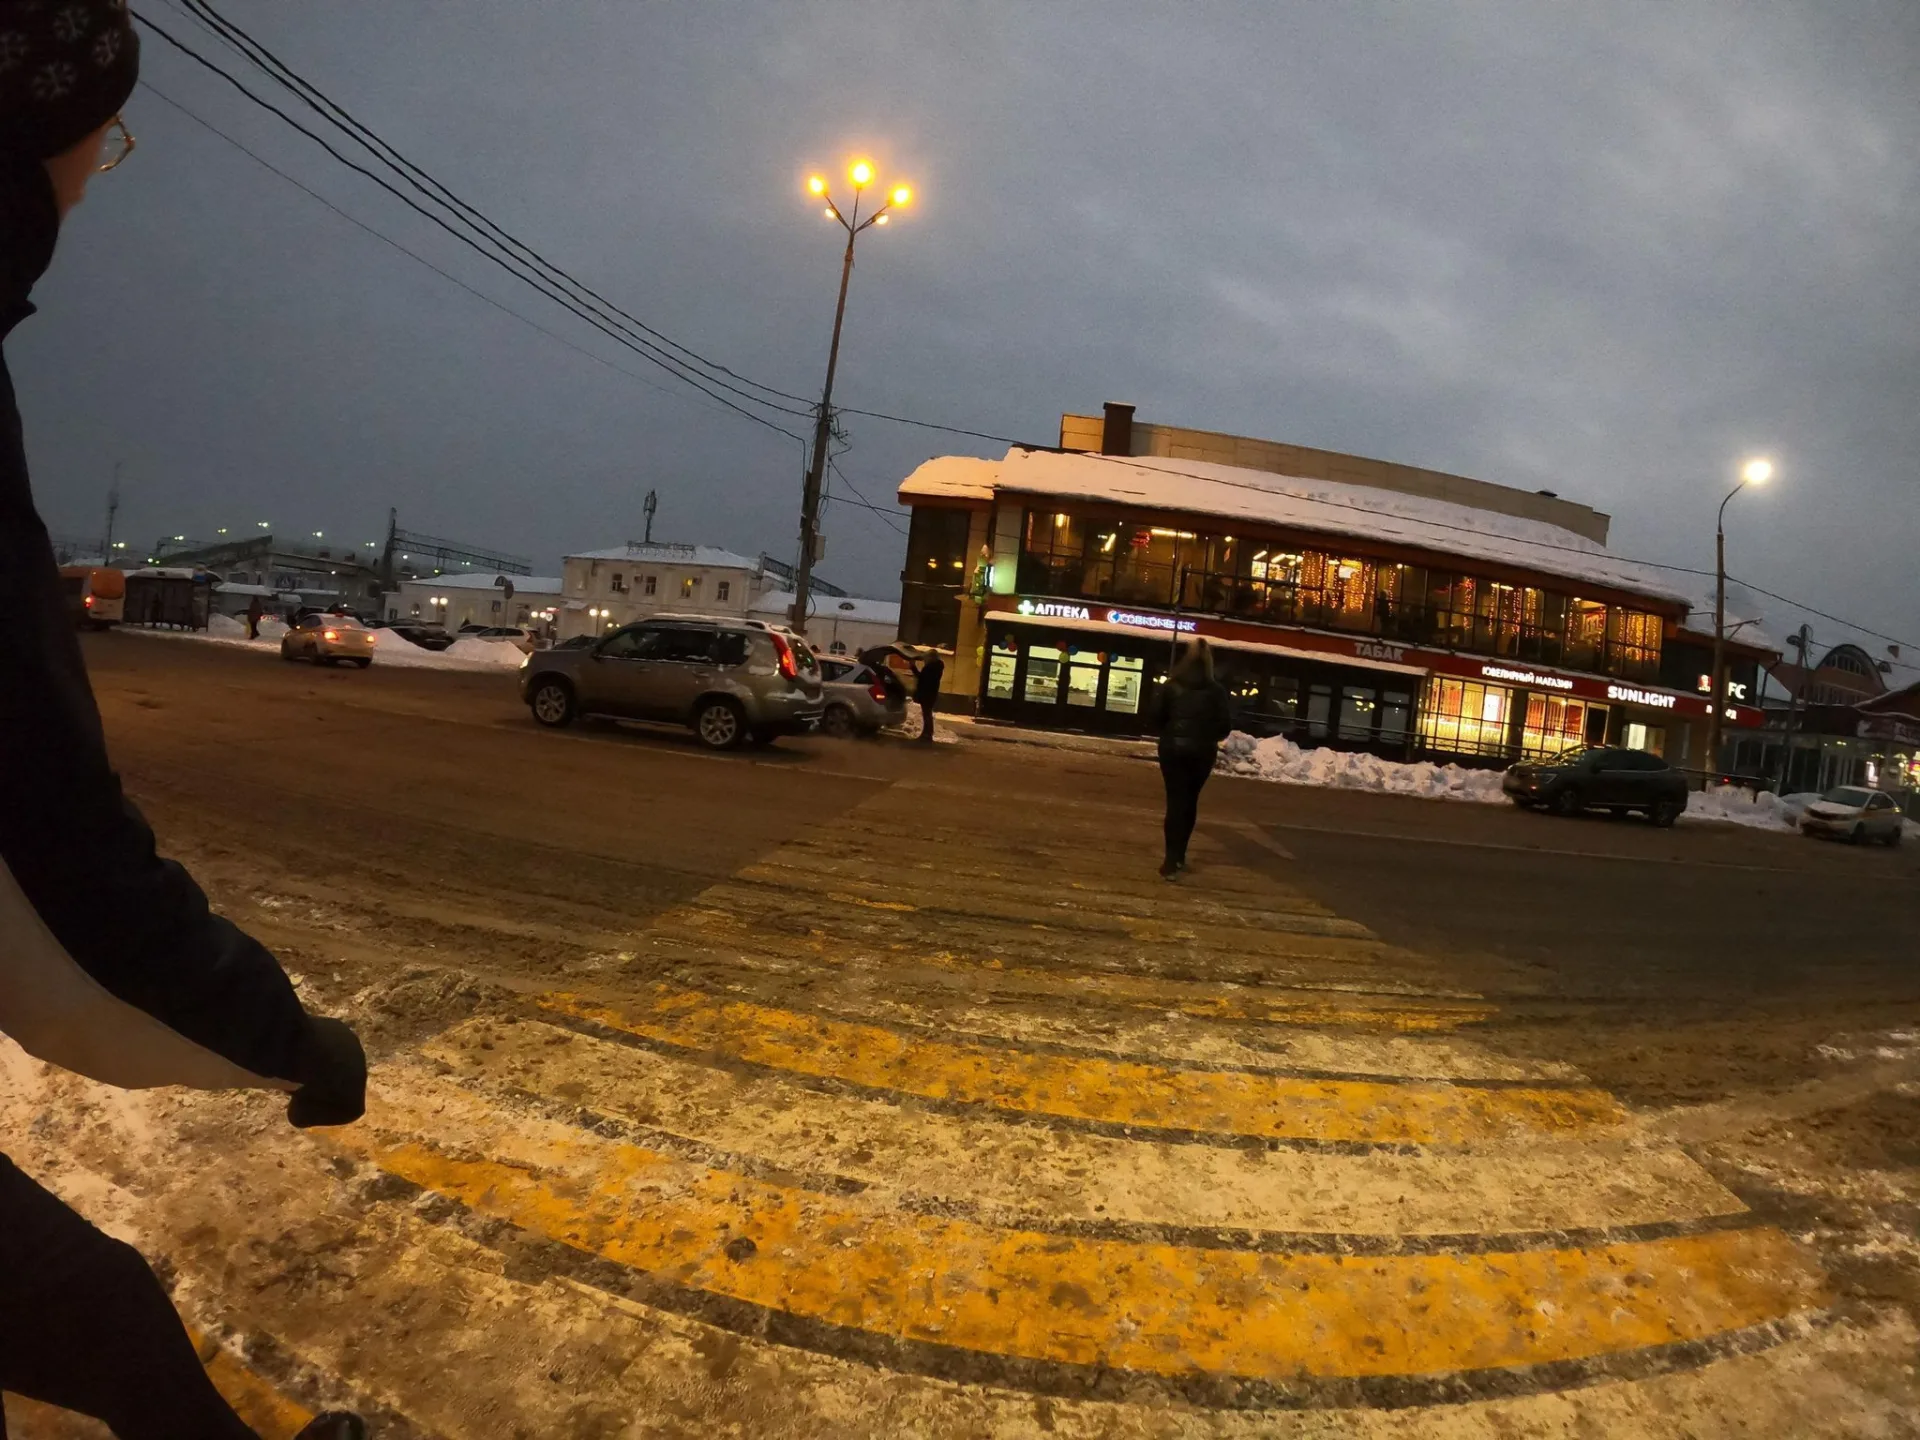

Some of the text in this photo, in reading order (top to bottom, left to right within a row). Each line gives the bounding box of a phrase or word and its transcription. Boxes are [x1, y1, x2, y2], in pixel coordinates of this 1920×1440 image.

[1035, 603, 1090, 620] АПТЕКА
[1354, 642, 1404, 662] ТАБАК
[1535, 676, 1573, 689] МАГАЗИН
[1607, 685, 1676, 709] SUNLIGHT
